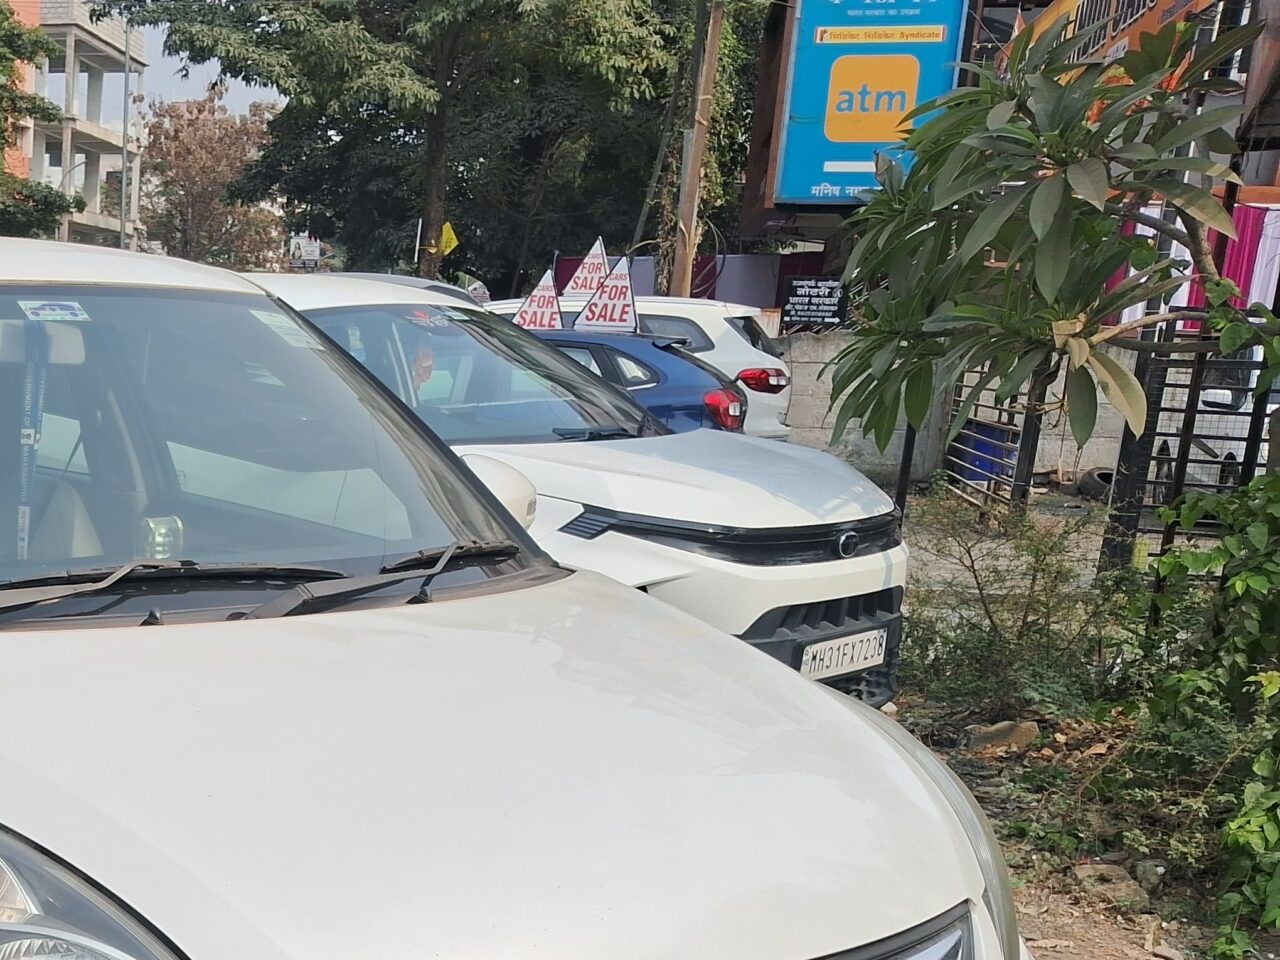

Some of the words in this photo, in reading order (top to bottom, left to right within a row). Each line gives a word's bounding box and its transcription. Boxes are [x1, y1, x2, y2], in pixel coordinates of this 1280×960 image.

[899, 30, 940, 40] Syndicate
[835, 83, 908, 113] atm
[581, 262, 603, 274] FOR
[571, 276, 605, 291] SALE
[609, 273, 629, 281] CARS
[598, 285, 629, 301] FOR
[528, 295, 556, 309] FOR
[517, 310, 558, 329] SALE
[585, 302, 631, 323] SALE
[808, 634, 885, 675] MH31FX7238
